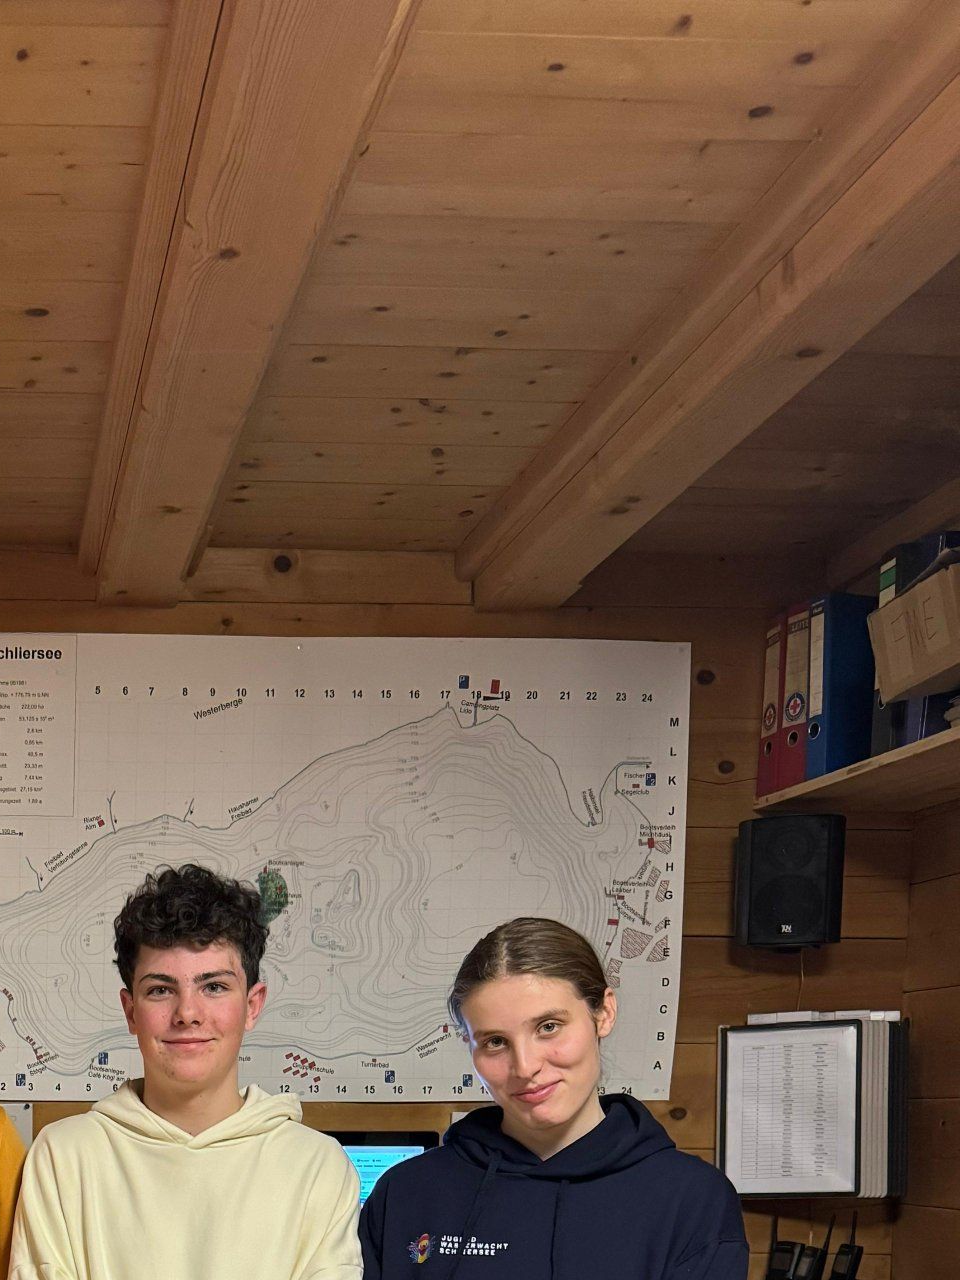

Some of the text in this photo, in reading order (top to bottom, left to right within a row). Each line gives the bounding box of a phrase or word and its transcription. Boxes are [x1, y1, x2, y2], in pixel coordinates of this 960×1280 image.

[95, 685, 101, 696] 5
[122, 685, 129, 696] 6
[148, 686, 155, 697] 7
[182, 687, 188, 697] 8
[209, 687, 216, 697] 9
[236, 688, 247, 698] 10
[265, 688, 275, 698] 11
[294, 688, 306, 698] 12
[324, 689, 335, 699] 13
[352, 689, 363, 699] 14
[381, 689, 392, 699] 15
[408, 689, 420, 699] 16
[440, 690, 451, 700] 17
[471, 690, 482, 700] 18
[526, 690, 538, 700] 20
[559, 691, 570, 701] 21
[586, 691, 598, 701] 22
[615, 692, 627, 702] 23
[641, 693, 653, 703] 24
[193, 697, 243, 720] Westerberge
[669, 717, 680, 727] M
[669, 746, 677, 757] L
[668, 775, 677, 786] K
[668, 806, 675, 816] J
[665, 861, 674, 872] H
[664, 890, 673, 900] G
[664, 919, 672, 930] F
[663, 947, 670, 958] E
[661, 977, 670, 987] D
[659, 1004, 668, 1014] C
[656, 1031, 665, 1041] B
[653, 1060, 662, 1070] A
[0, 1082, 7, 1091] 2
[28, 1082, 34, 1092] 3
[55, 1083, 62, 1092] 4
[86, 1083, 92, 1092] 5
[279, 1084, 290, 1093] 12
[308, 1084, 320, 1094] 13
[336, 1085, 347, 1094] 14
[364, 1085, 376, 1094] 15
[392, 1085, 404, 1095] 16
[422, 1085, 433, 1095] 17
[452, 1085, 463, 1095] 18
